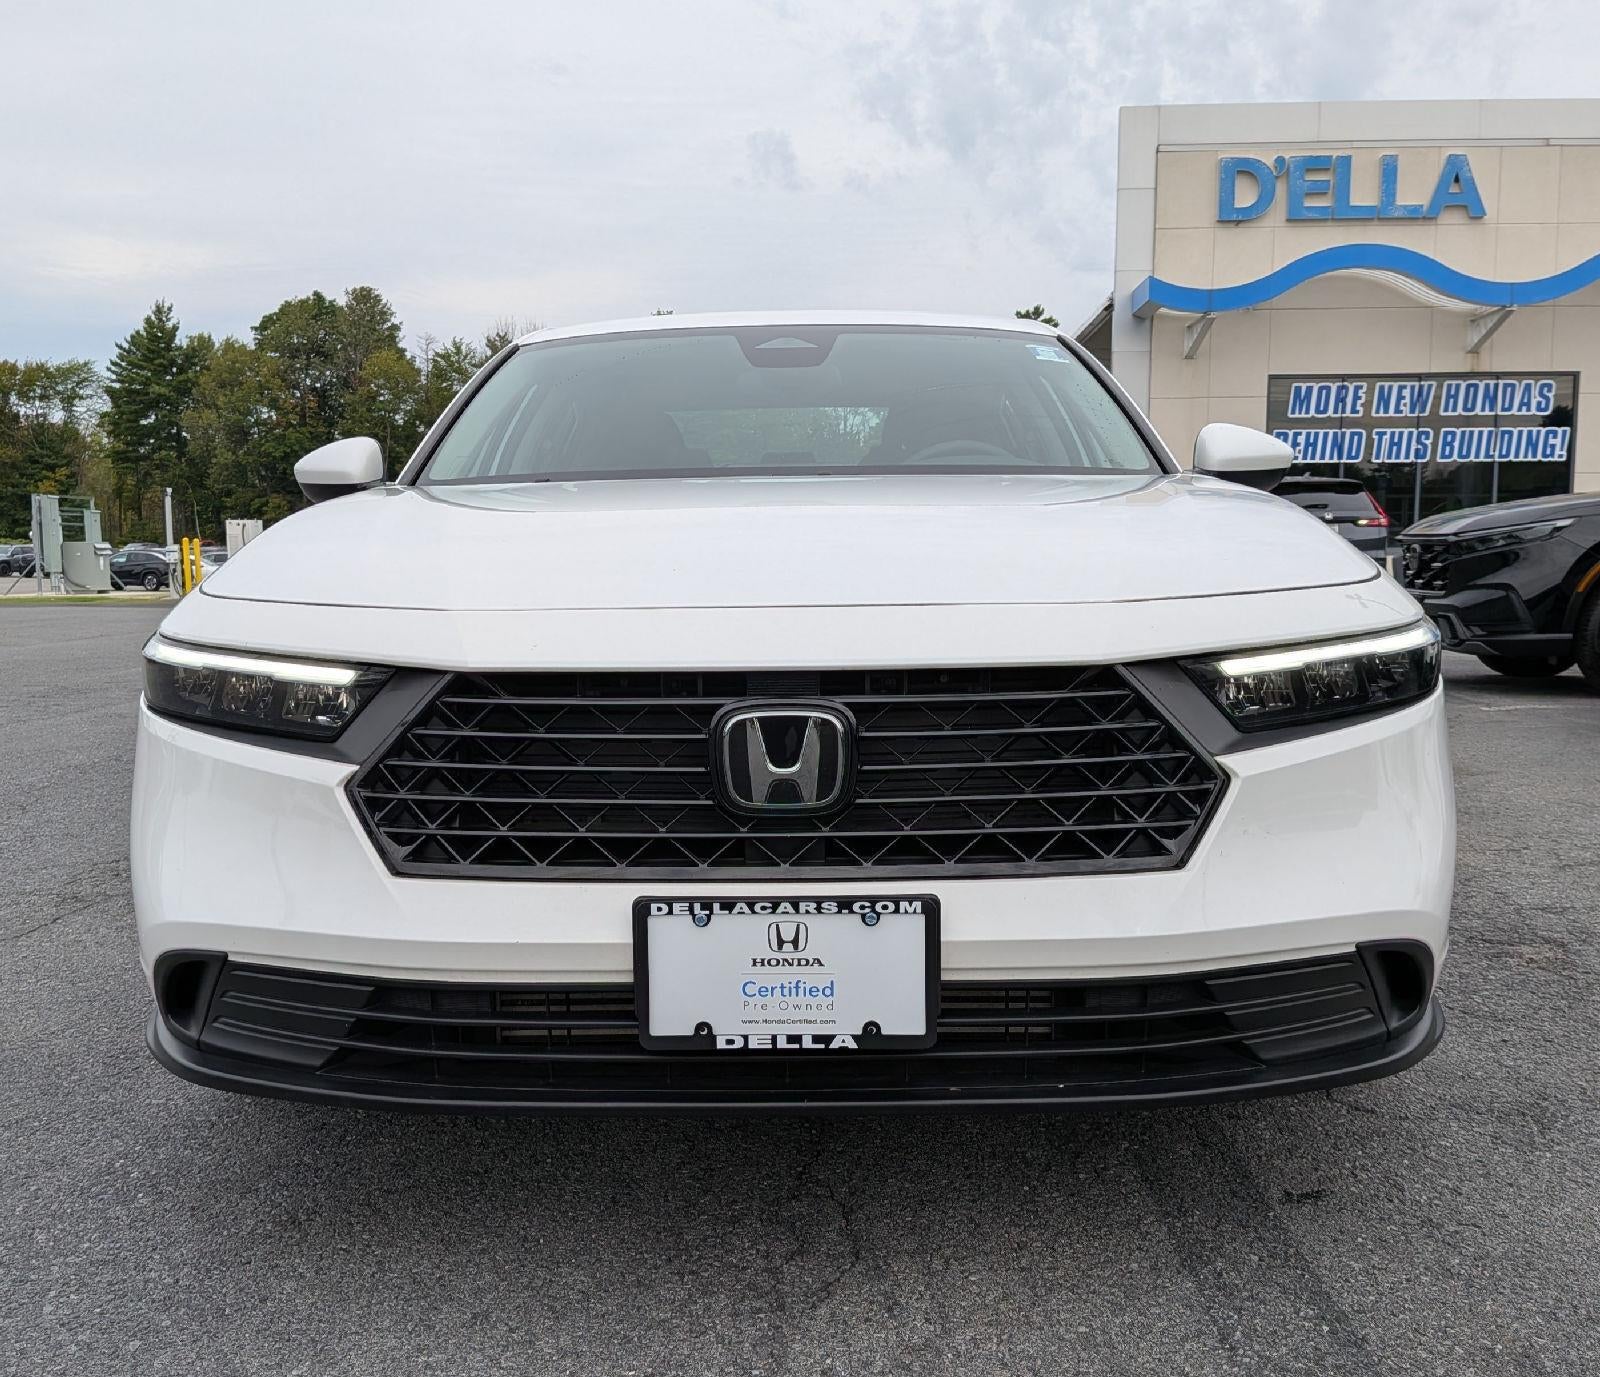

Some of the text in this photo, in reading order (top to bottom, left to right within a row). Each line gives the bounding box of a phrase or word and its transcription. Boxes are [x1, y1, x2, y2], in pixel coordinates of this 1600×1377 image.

[1217, 153, 1487, 222] D'ELLA
[1288, 380, 1555, 417] MORE NEW HONDAS
[1371, 428, 1432, 463] THIS
[1438, 427, 1570, 462] BUILDING!
[650, 901, 922, 915] DELLACARS.COM
[751, 957, 825, 967] HONDA
[741, 980, 835, 998] Certified
[743, 1000, 834, 1011] Pre-Owned
[716, 1034, 858, 1049] DELLA
